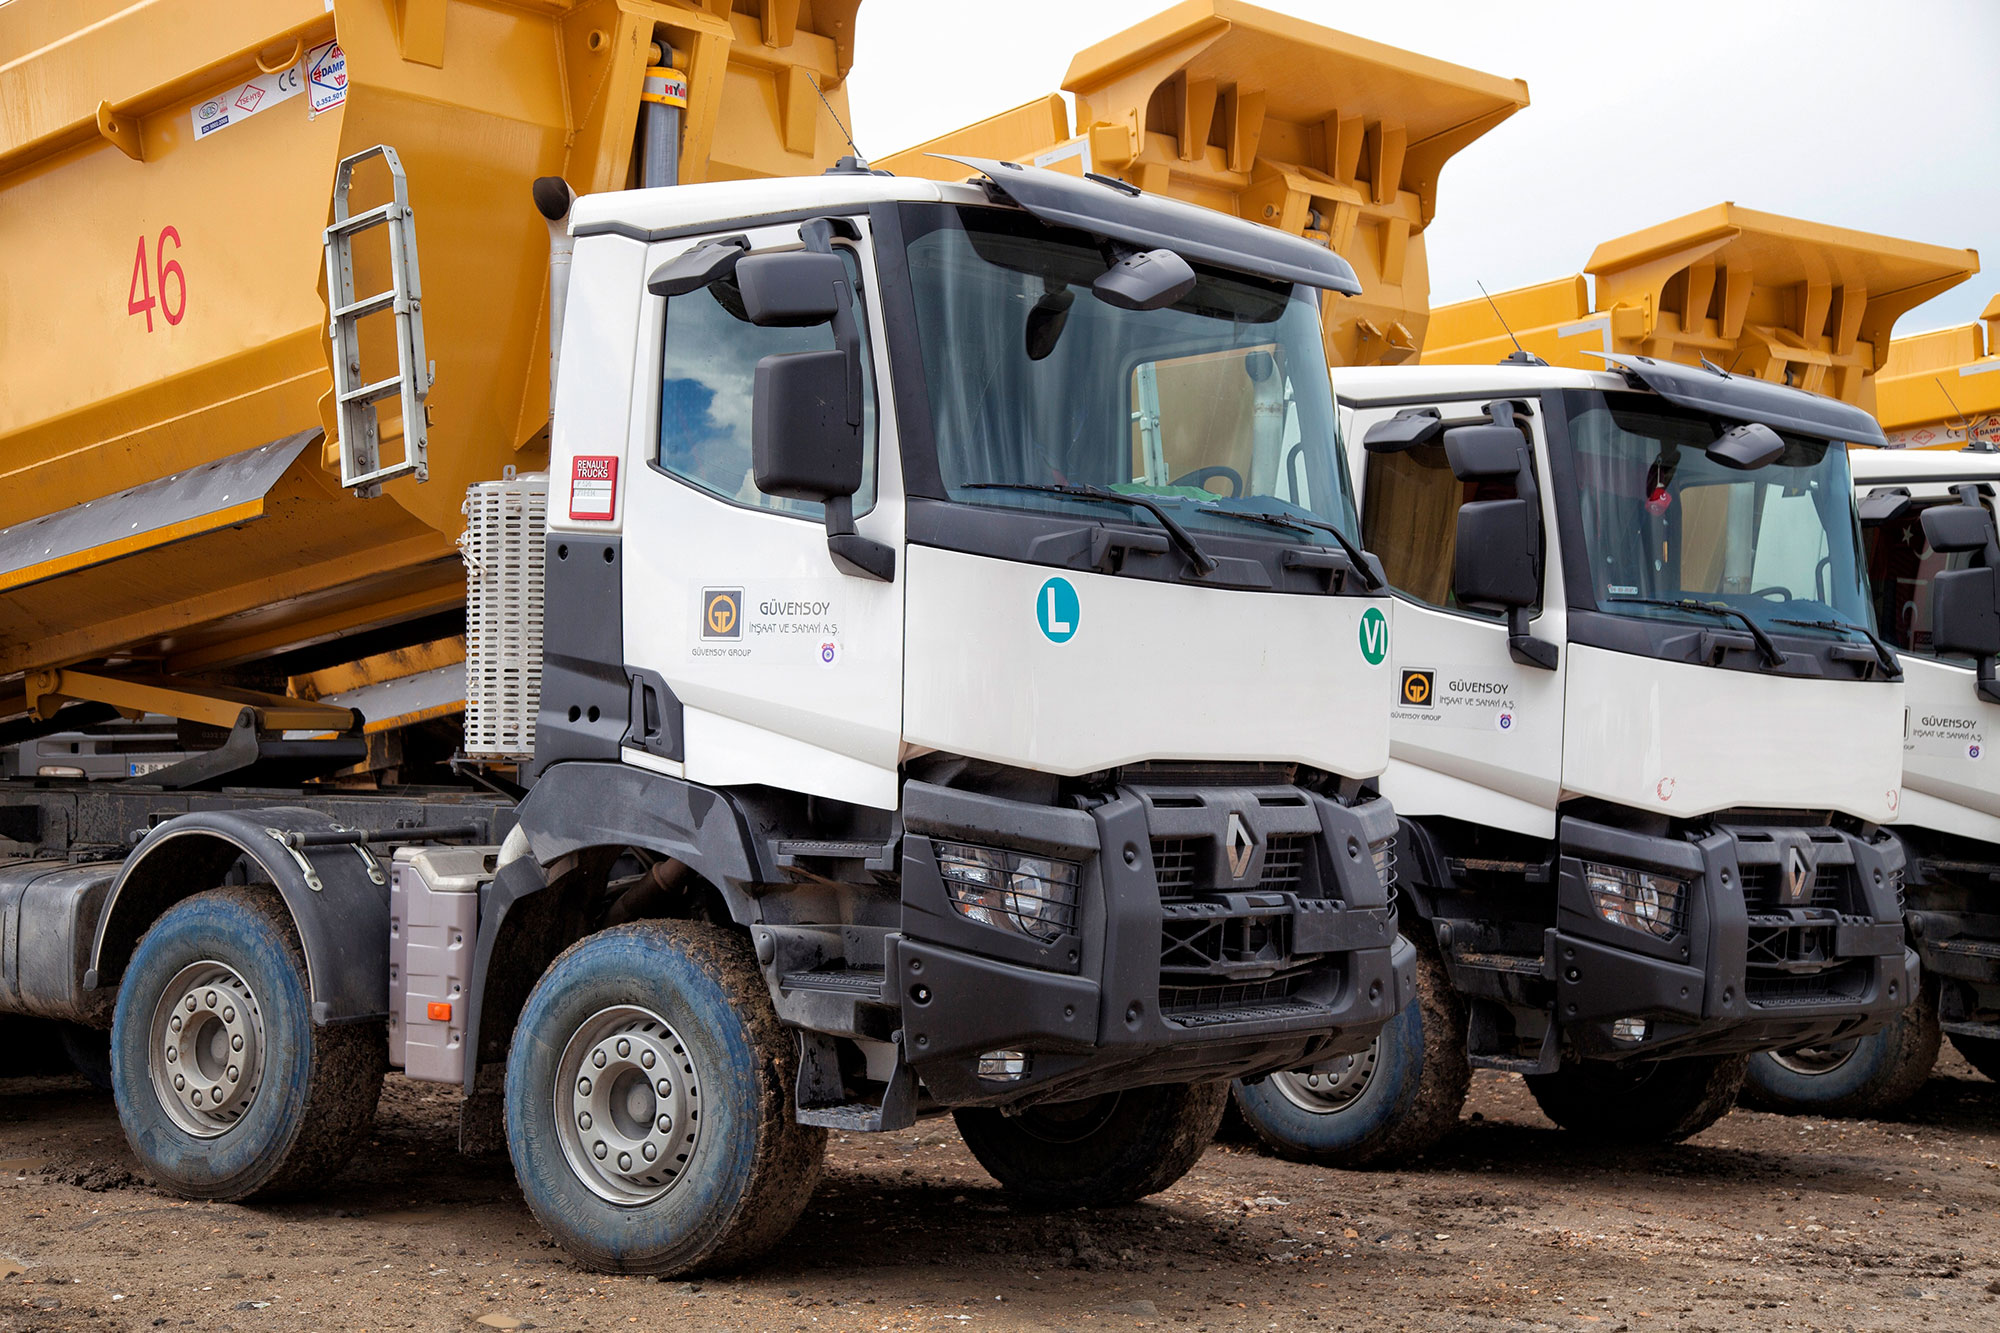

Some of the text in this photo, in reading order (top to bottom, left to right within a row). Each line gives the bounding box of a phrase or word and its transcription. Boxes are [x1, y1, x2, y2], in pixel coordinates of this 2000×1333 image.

[278, 68, 297, 92] CE
[128, 225, 187, 333] 46
[577, 460, 609, 469] RENAULT
[577, 469, 609, 478] TRUCKS
[759, 598, 831, 616] GÜVENSOY
[1047, 587, 1070, 633] L
[749, 621, 840, 636] İNŞAAT VE SANAYİ A.Ş.
[1363, 617, 1386, 656] VI
[691, 646, 752, 657] GÜVENSOY GROUP
[1448, 679, 1509, 695] GÜVENSOY
[1464, 697, 1474, 706] VE
[1421, 713, 1442, 721] GROUP
[1921, 715, 1977, 730] GÜVENSOY
[1936, 731, 1945, 739] VE
